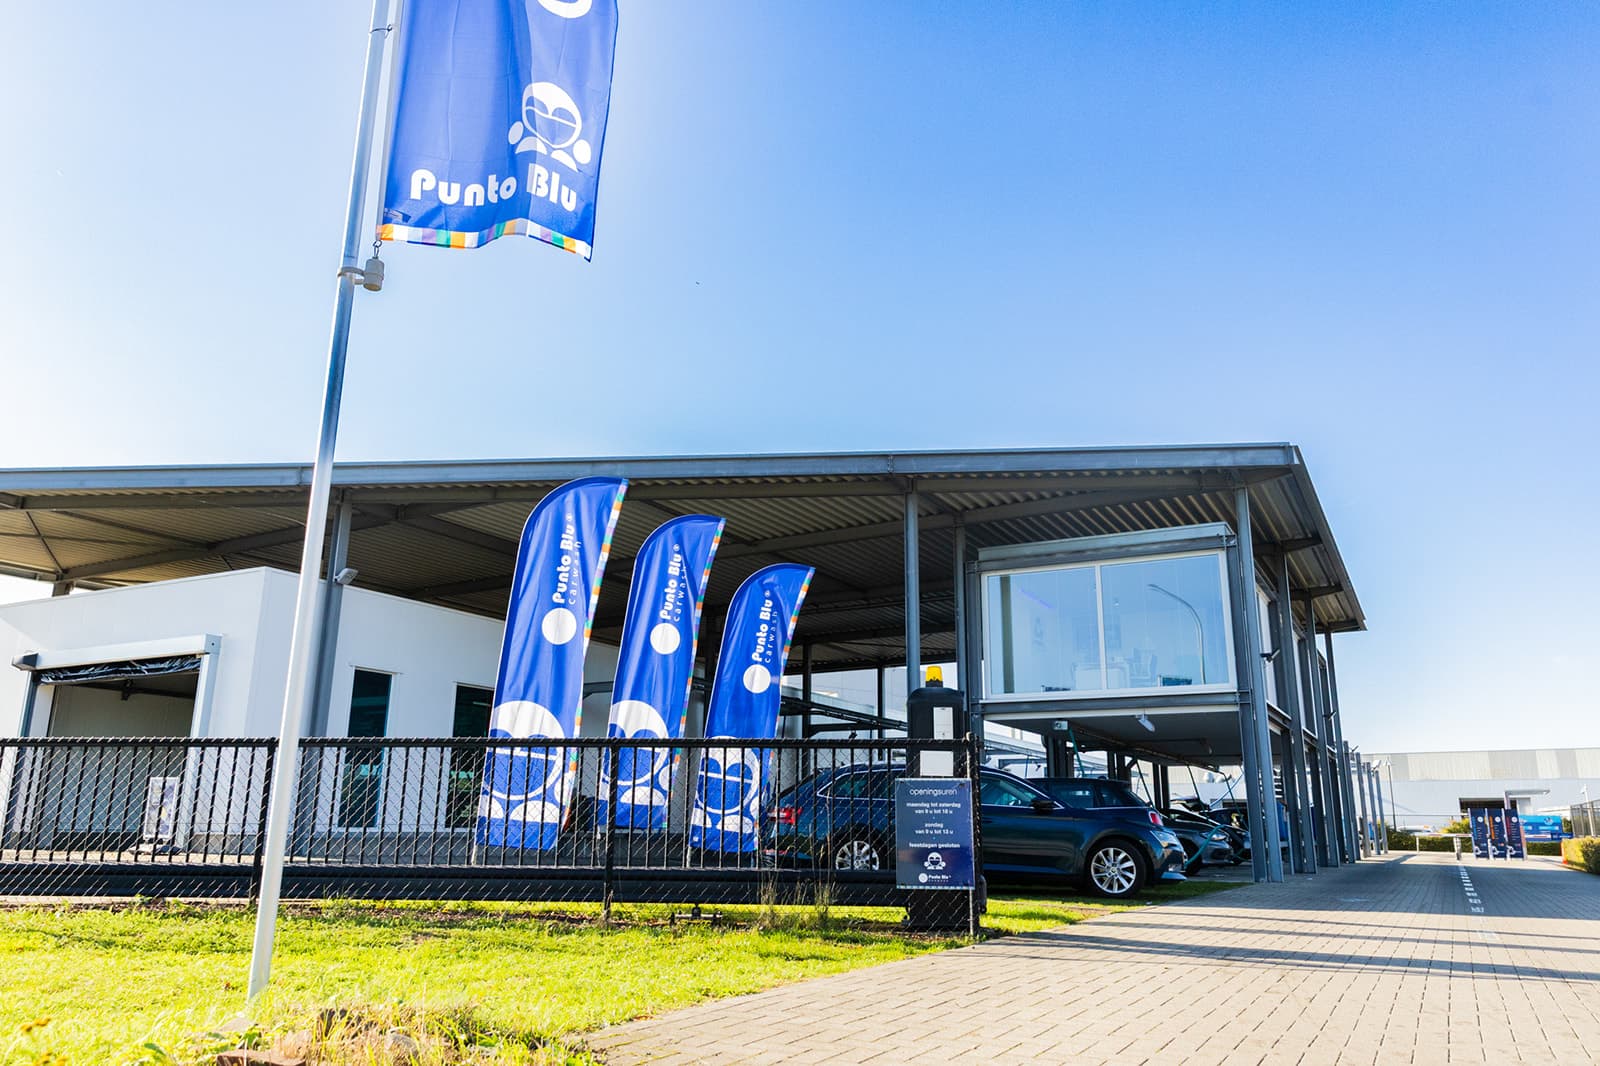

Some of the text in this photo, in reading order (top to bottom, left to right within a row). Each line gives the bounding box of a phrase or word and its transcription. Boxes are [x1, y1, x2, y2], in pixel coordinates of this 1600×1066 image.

[410, 163, 577, 212] Punto Blu
[552, 554, 572, 604] Punto
[568, 541, 582, 605] carwash
[673, 566, 687, 622] carwash
[659, 579, 678, 620] Punto
[751, 623, 769, 662] Punto
[764, 611, 778, 663] carwash
[909, 788, 957, 797] openingsuren
